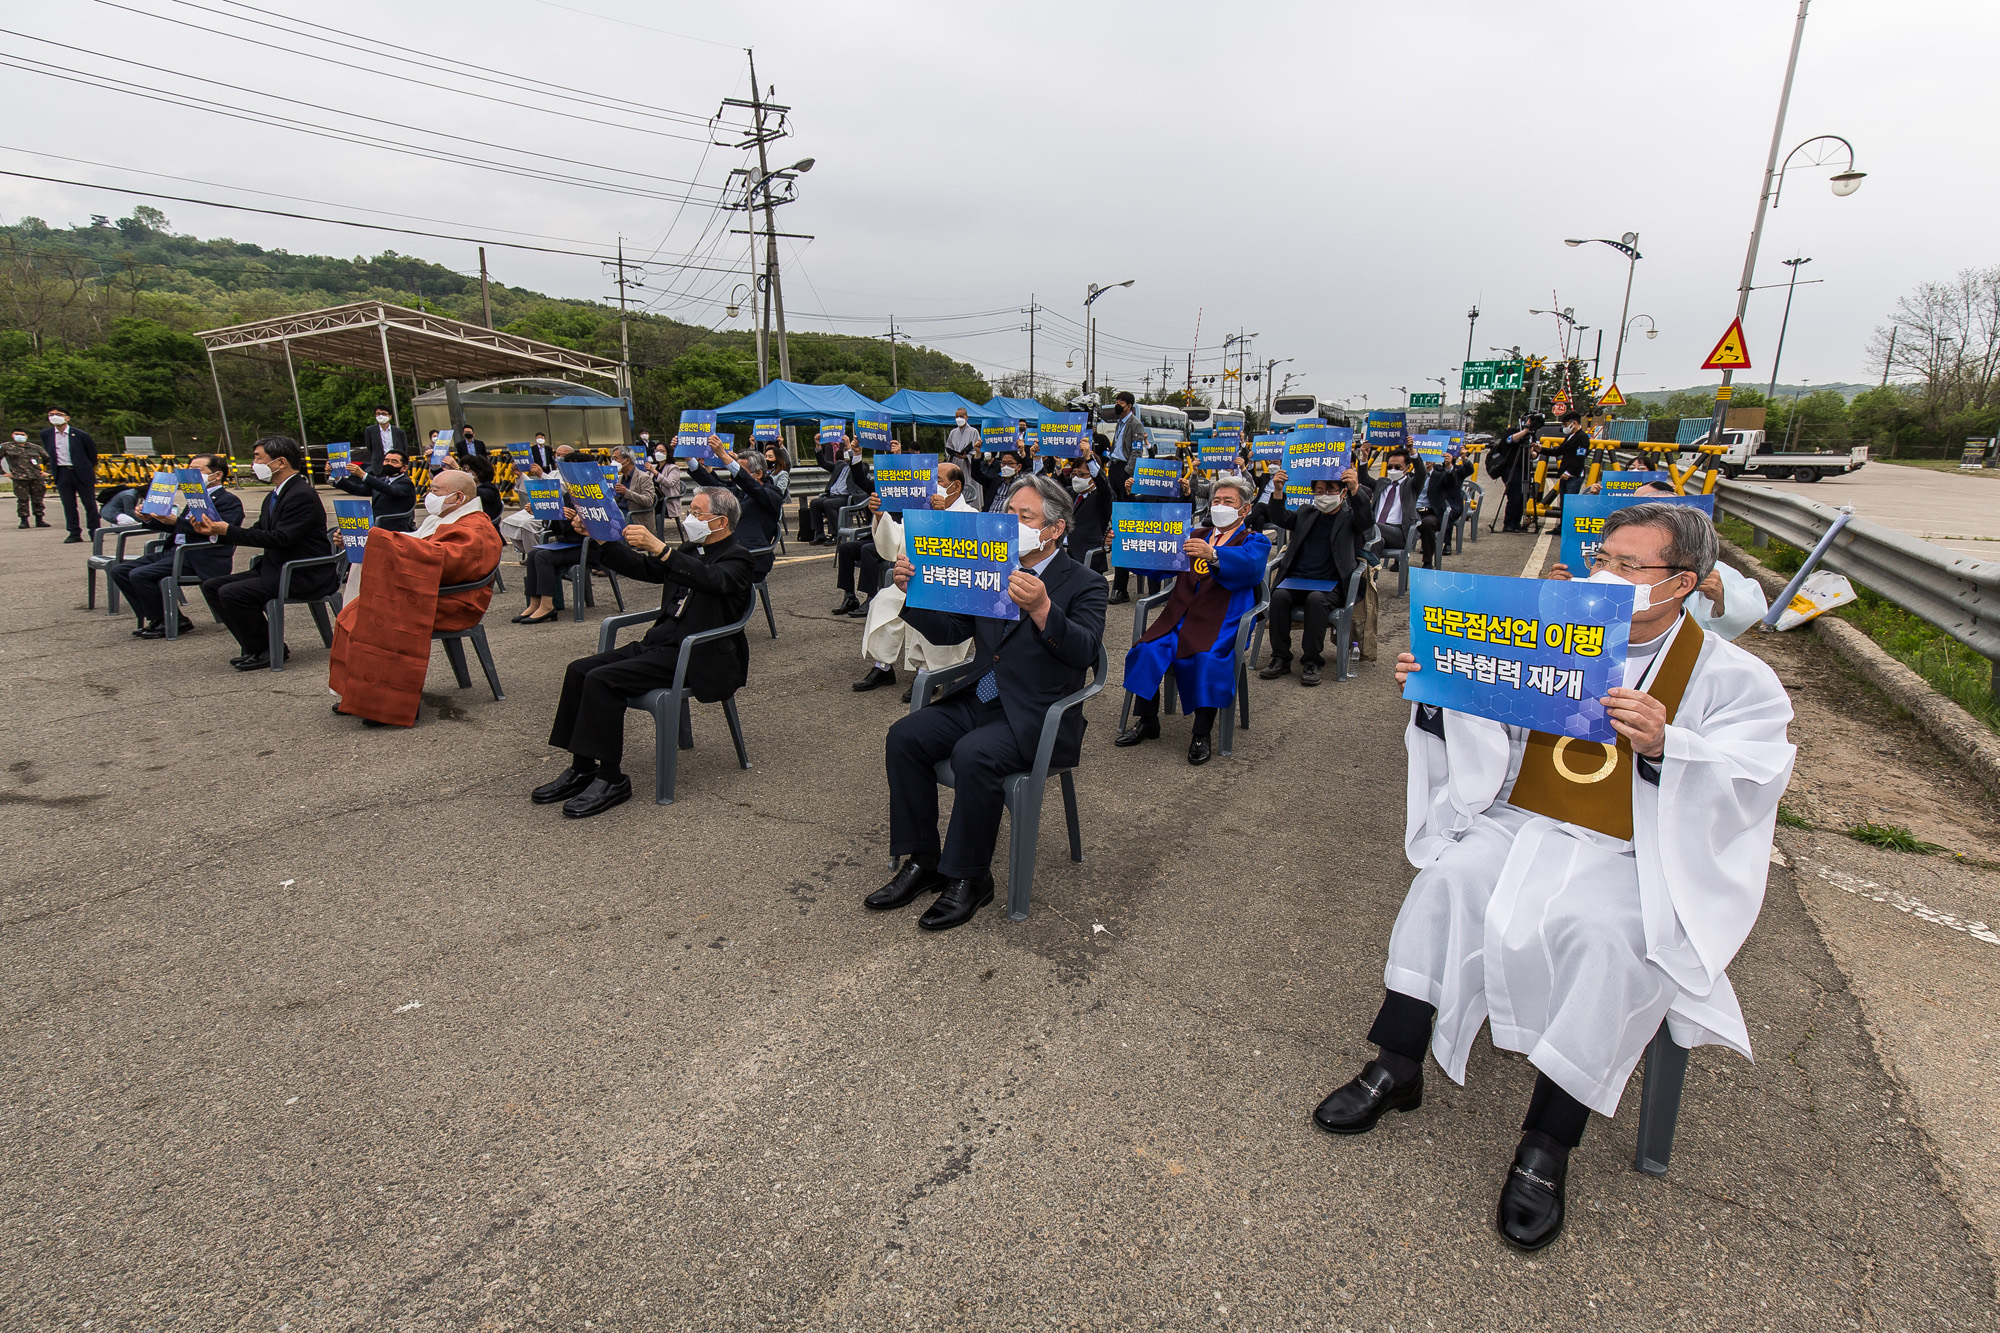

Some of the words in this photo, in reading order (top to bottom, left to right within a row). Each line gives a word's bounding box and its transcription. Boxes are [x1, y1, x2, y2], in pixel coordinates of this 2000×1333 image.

[699, 423, 711, 432] 이행
[858, 420, 879, 430] 판문점선언
[879, 422, 888, 431] 이행
[983, 427, 1004, 435] 판문점선언
[1040, 423, 1068, 433] 판문점선언
[1069, 424, 1082, 432] 이행
[696, 437, 707, 446] 재개
[860, 431, 877, 440] 남북협력
[1042, 436, 1064, 446] 남북협력
[1065, 436, 1078, 445] 재개
[1289, 441, 1326, 454] 판문점선언
[1328, 442, 1345, 452] 이행
[1290, 457, 1320, 468] 남북협력
[1322, 457, 1340, 467] 재개
[876, 469, 912, 481] 판문점선언
[913, 470, 931, 481] 이행
[1138, 467, 1165, 477] 판문점선언
[1165, 469, 1177, 478] 이행
[1139, 478, 1161, 487] 남북협력
[1162, 480, 1173, 488] 재개
[583, 484, 604, 499] 이행
[880, 486, 908, 497] 남북협력
[910, 487, 926, 498] 재개
[588, 507, 609, 521] 재개
[357, 517, 369, 529] 이행
[1118, 520, 1162, 534] 판문점선언
[1163, 522, 1183, 535] 이행
[914, 536, 978, 560] 판문점선언
[981, 541, 1008, 562] 이행
[1121, 539, 1156, 553] 남북협력
[1158, 541, 1177, 554] 재개
[922, 565, 971, 589] 남북협력
[974, 571, 1001, 592] 재개
[1423, 605, 1538, 649] 판문점선언
[1545, 625, 1605, 658] 이행
[1433, 645, 1522, 690] 남북협력
[1527, 665, 1584, 700] 재개
